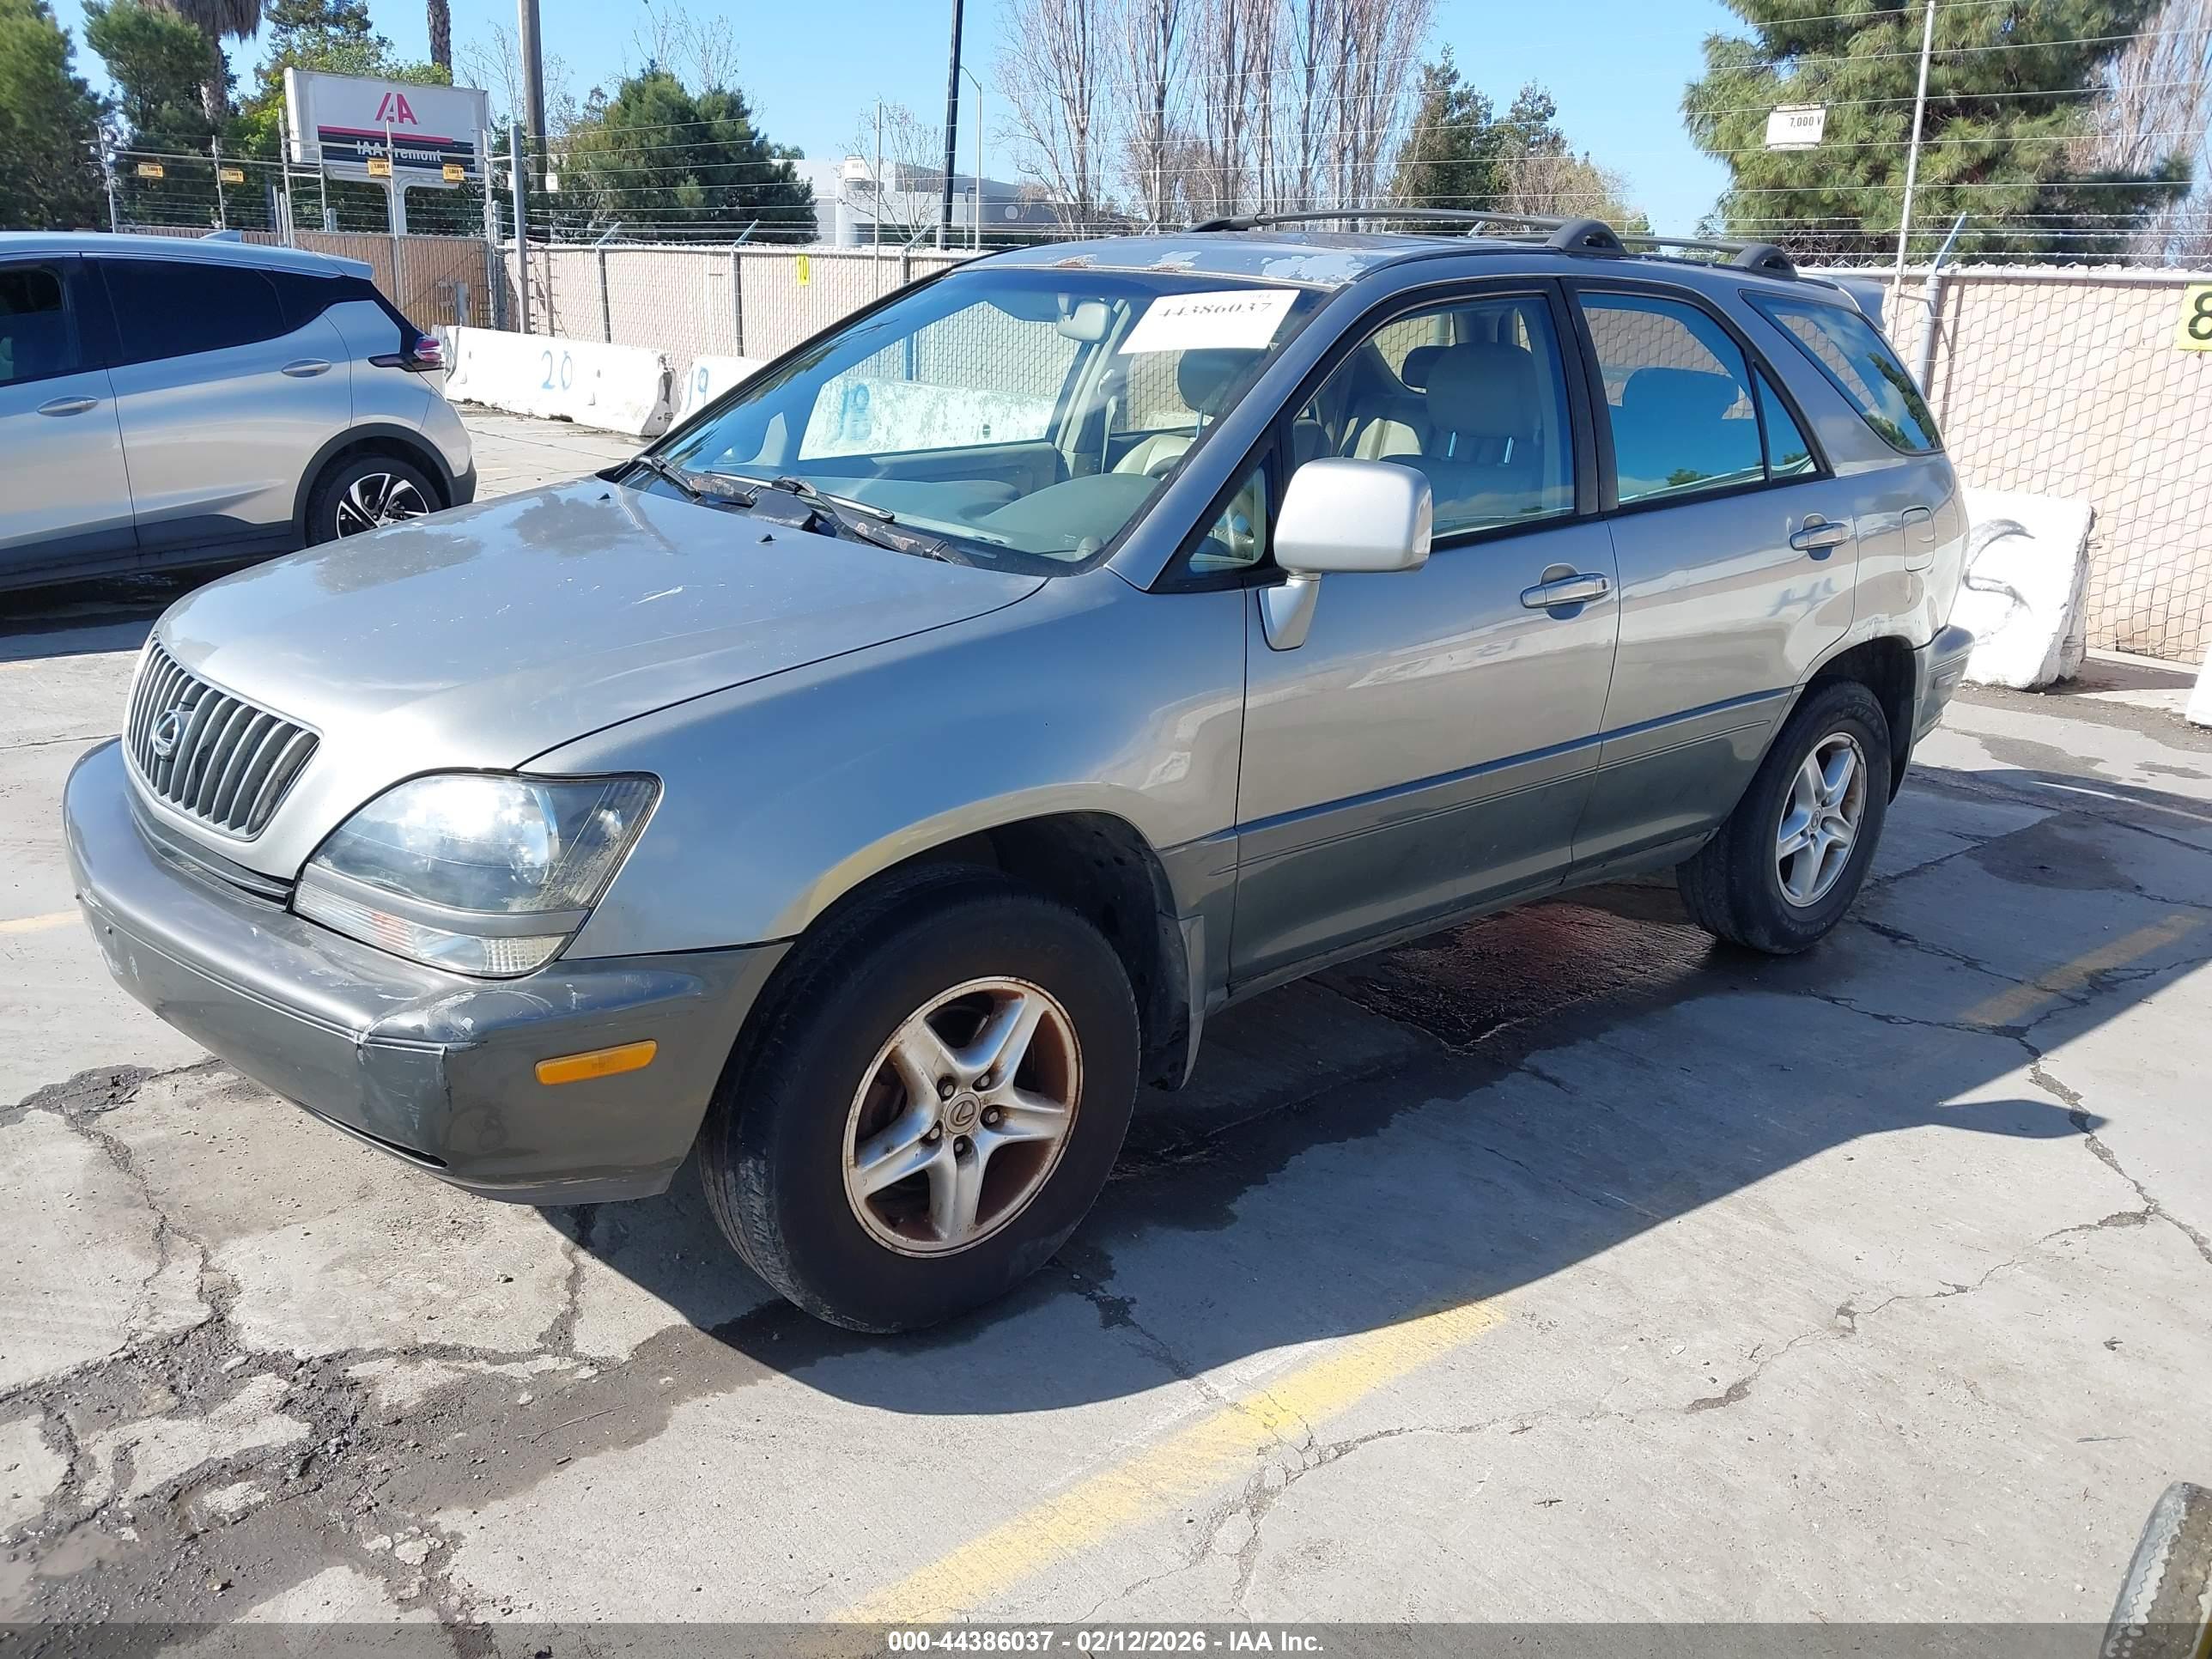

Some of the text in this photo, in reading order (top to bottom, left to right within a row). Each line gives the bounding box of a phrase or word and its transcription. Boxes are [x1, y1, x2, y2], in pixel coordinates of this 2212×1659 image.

[1790, 115, 1822, 128] 7,000 V
[356, 140, 384, 157] IAA
[541, 349, 573, 391] 20
